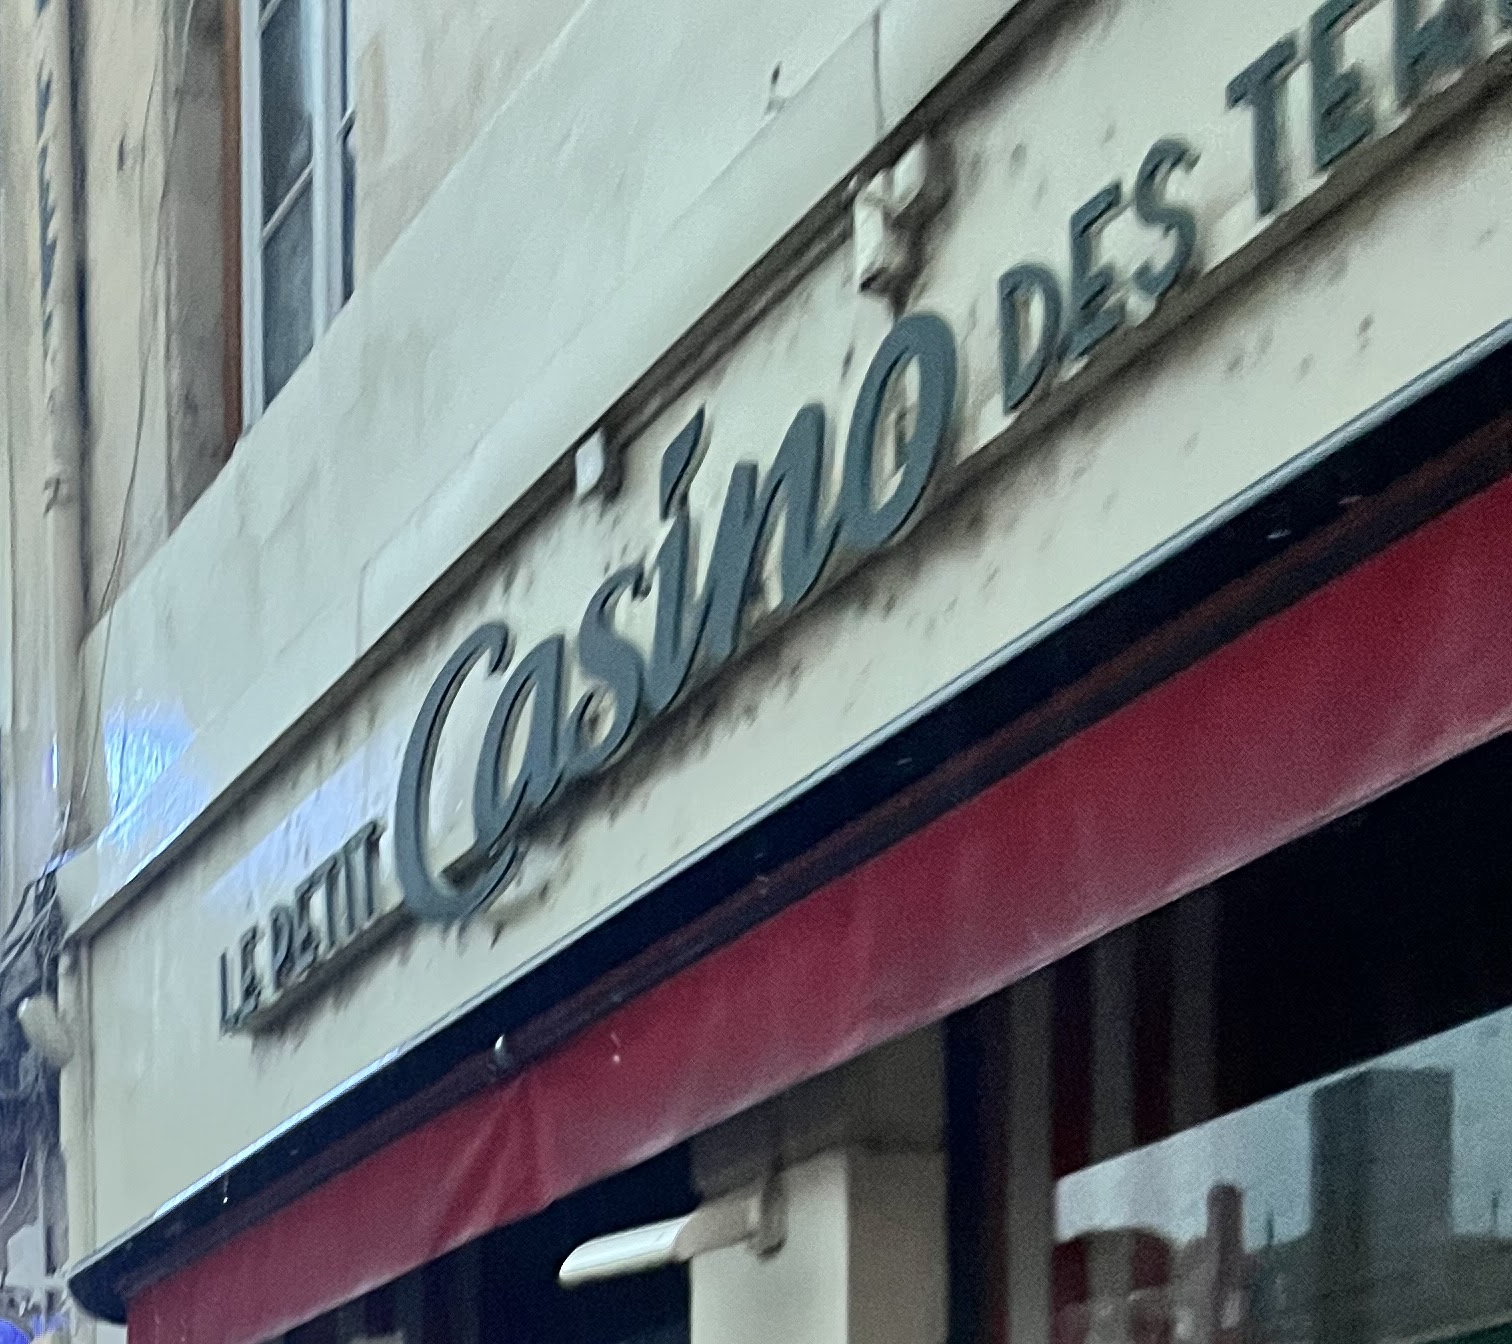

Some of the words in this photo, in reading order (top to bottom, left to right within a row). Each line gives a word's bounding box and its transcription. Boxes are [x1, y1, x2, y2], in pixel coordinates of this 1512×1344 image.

[220, 922, 263, 1035] LE
[270, 820, 385, 995] PETIT
[393, 311, 958, 922] Casino
[998, 134, 1201, 416] DES
[1225, 0, 1512, 219] TER
